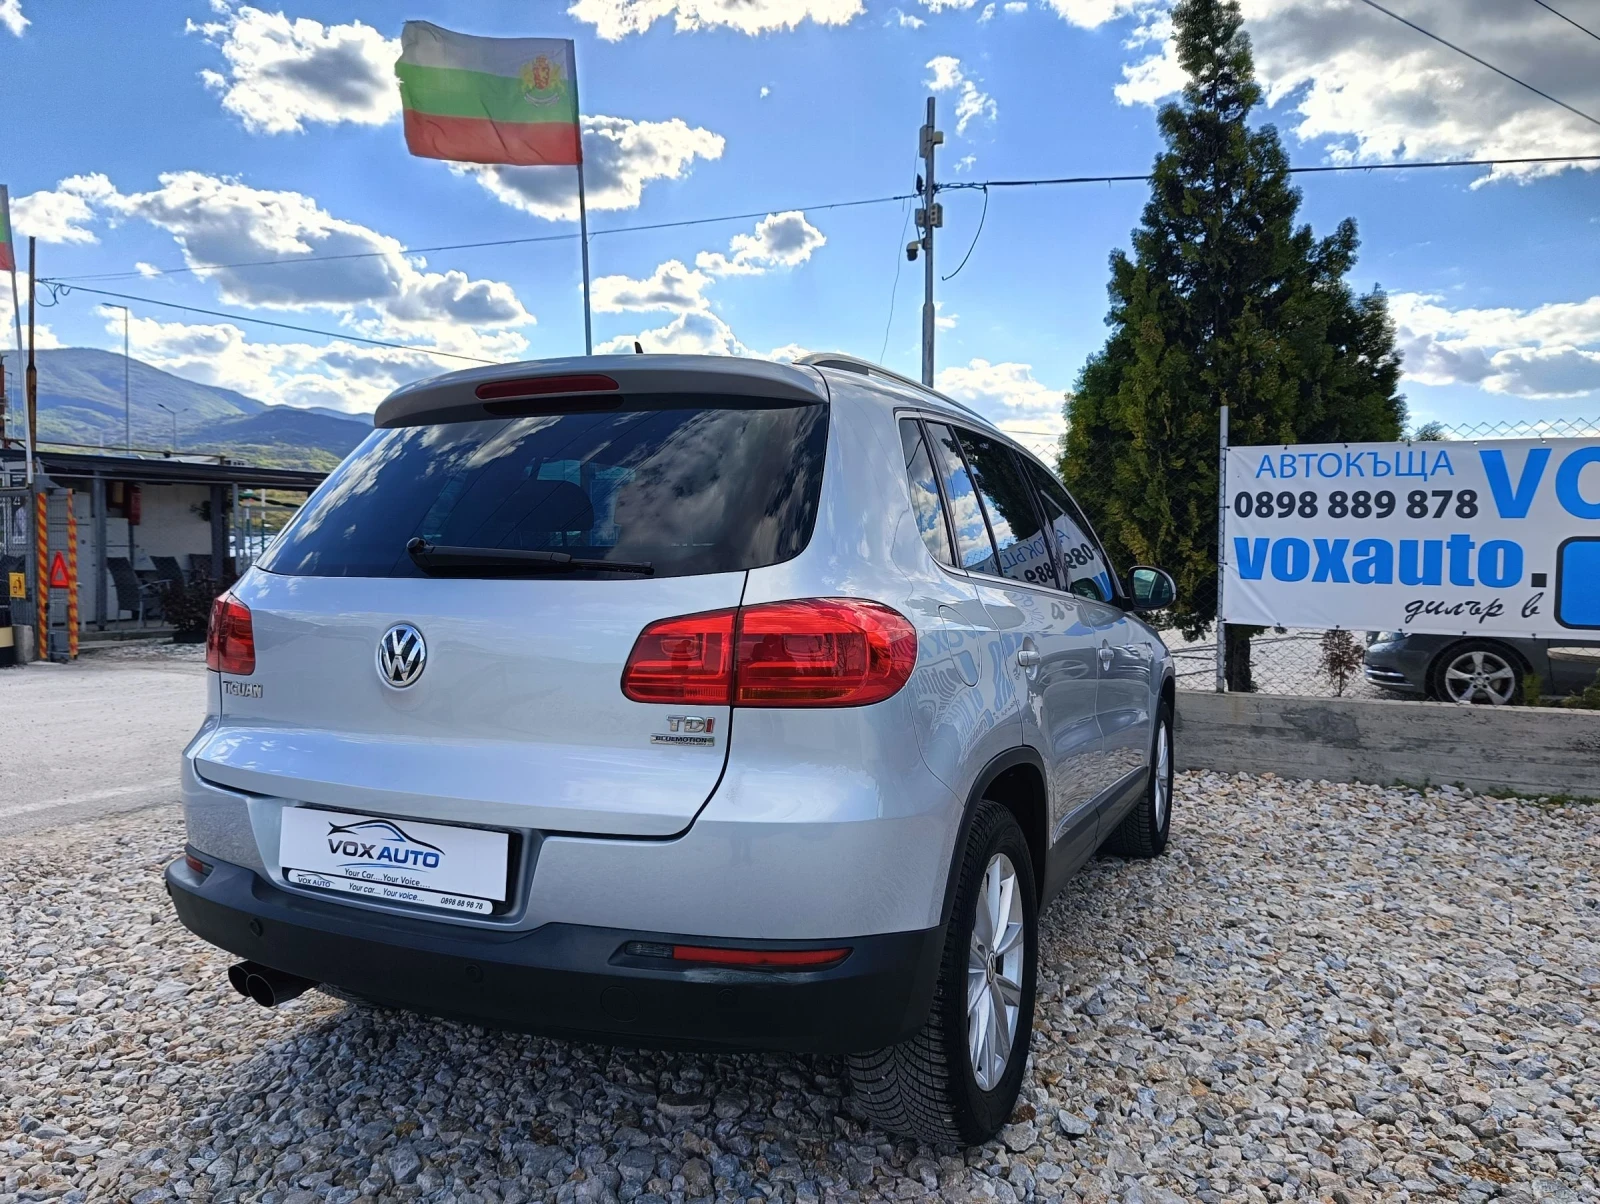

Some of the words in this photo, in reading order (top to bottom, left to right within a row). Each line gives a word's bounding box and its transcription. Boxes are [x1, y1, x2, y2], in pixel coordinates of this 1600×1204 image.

[1255, 450, 1455, 481] АВТОКЪЩА
[1234, 491, 1318, 519] 0898
[1327, 490, 1397, 518] 889
[1406, 490, 1479, 518] 878
[223, 681, 263, 698] TIGUAN
[667, 715, 715, 733] TDI
[328, 839, 375, 859] VOX
[377, 847, 439, 868] AUTO
[298, 877, 311, 885] VOX
[312, 879, 331, 888] AUTO
[383, 888, 398, 897] Your
[440, 897, 456, 906] 0898
